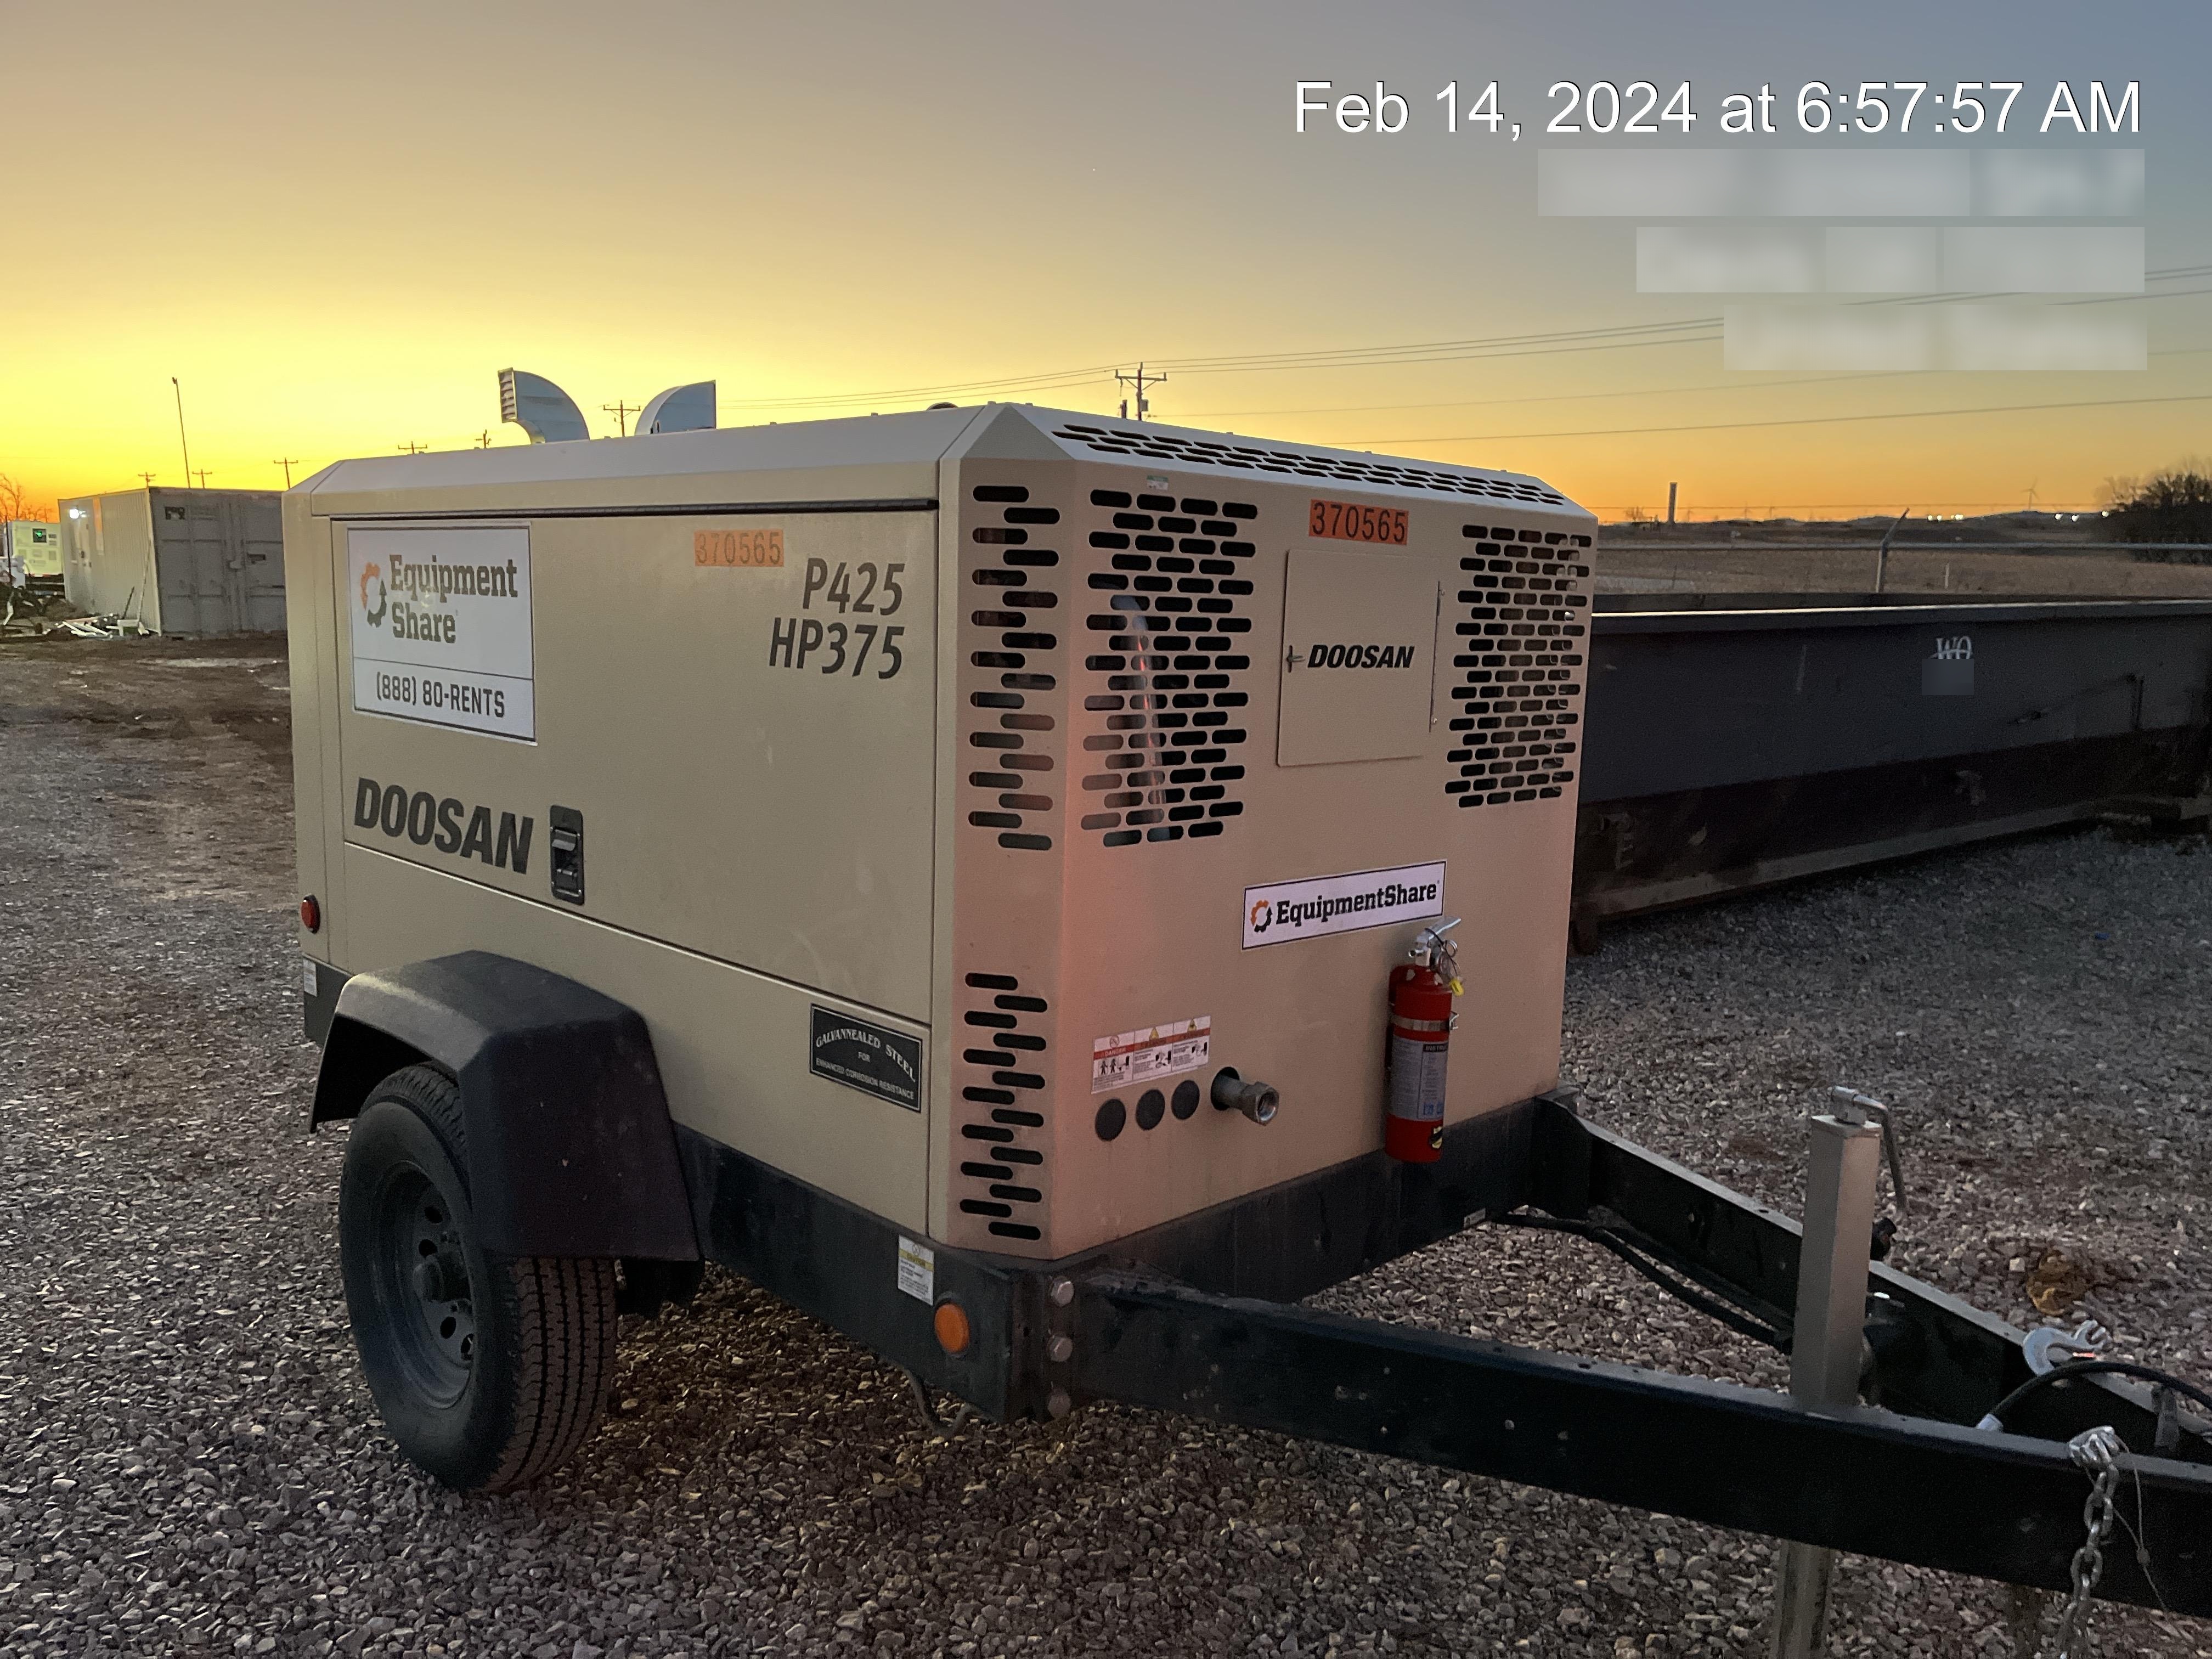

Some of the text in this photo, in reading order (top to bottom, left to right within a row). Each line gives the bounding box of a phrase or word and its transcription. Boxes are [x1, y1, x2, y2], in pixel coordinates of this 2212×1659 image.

[1311, 501, 1406, 543] 370565
[695, 531, 782, 565] 370565
[389, 554, 518, 603] Equipment
[802, 557, 906, 616] P425
[391, 601, 456, 644] Share
[769, 617, 905, 680] HP375
[1307, 644, 1415, 669] DOOSAN
[376, 672, 505, 718] (888) 80-RENTS
[354, 776, 534, 875] DOOSAN
[1276, 883, 1437, 927] EquipmentShare
[815, 1028, 916, 1083] GALVANNEALED STEEL
[857, 1051, 871, 1063] FOR
[879, 1080, 914, 1100] RESISTANCE
